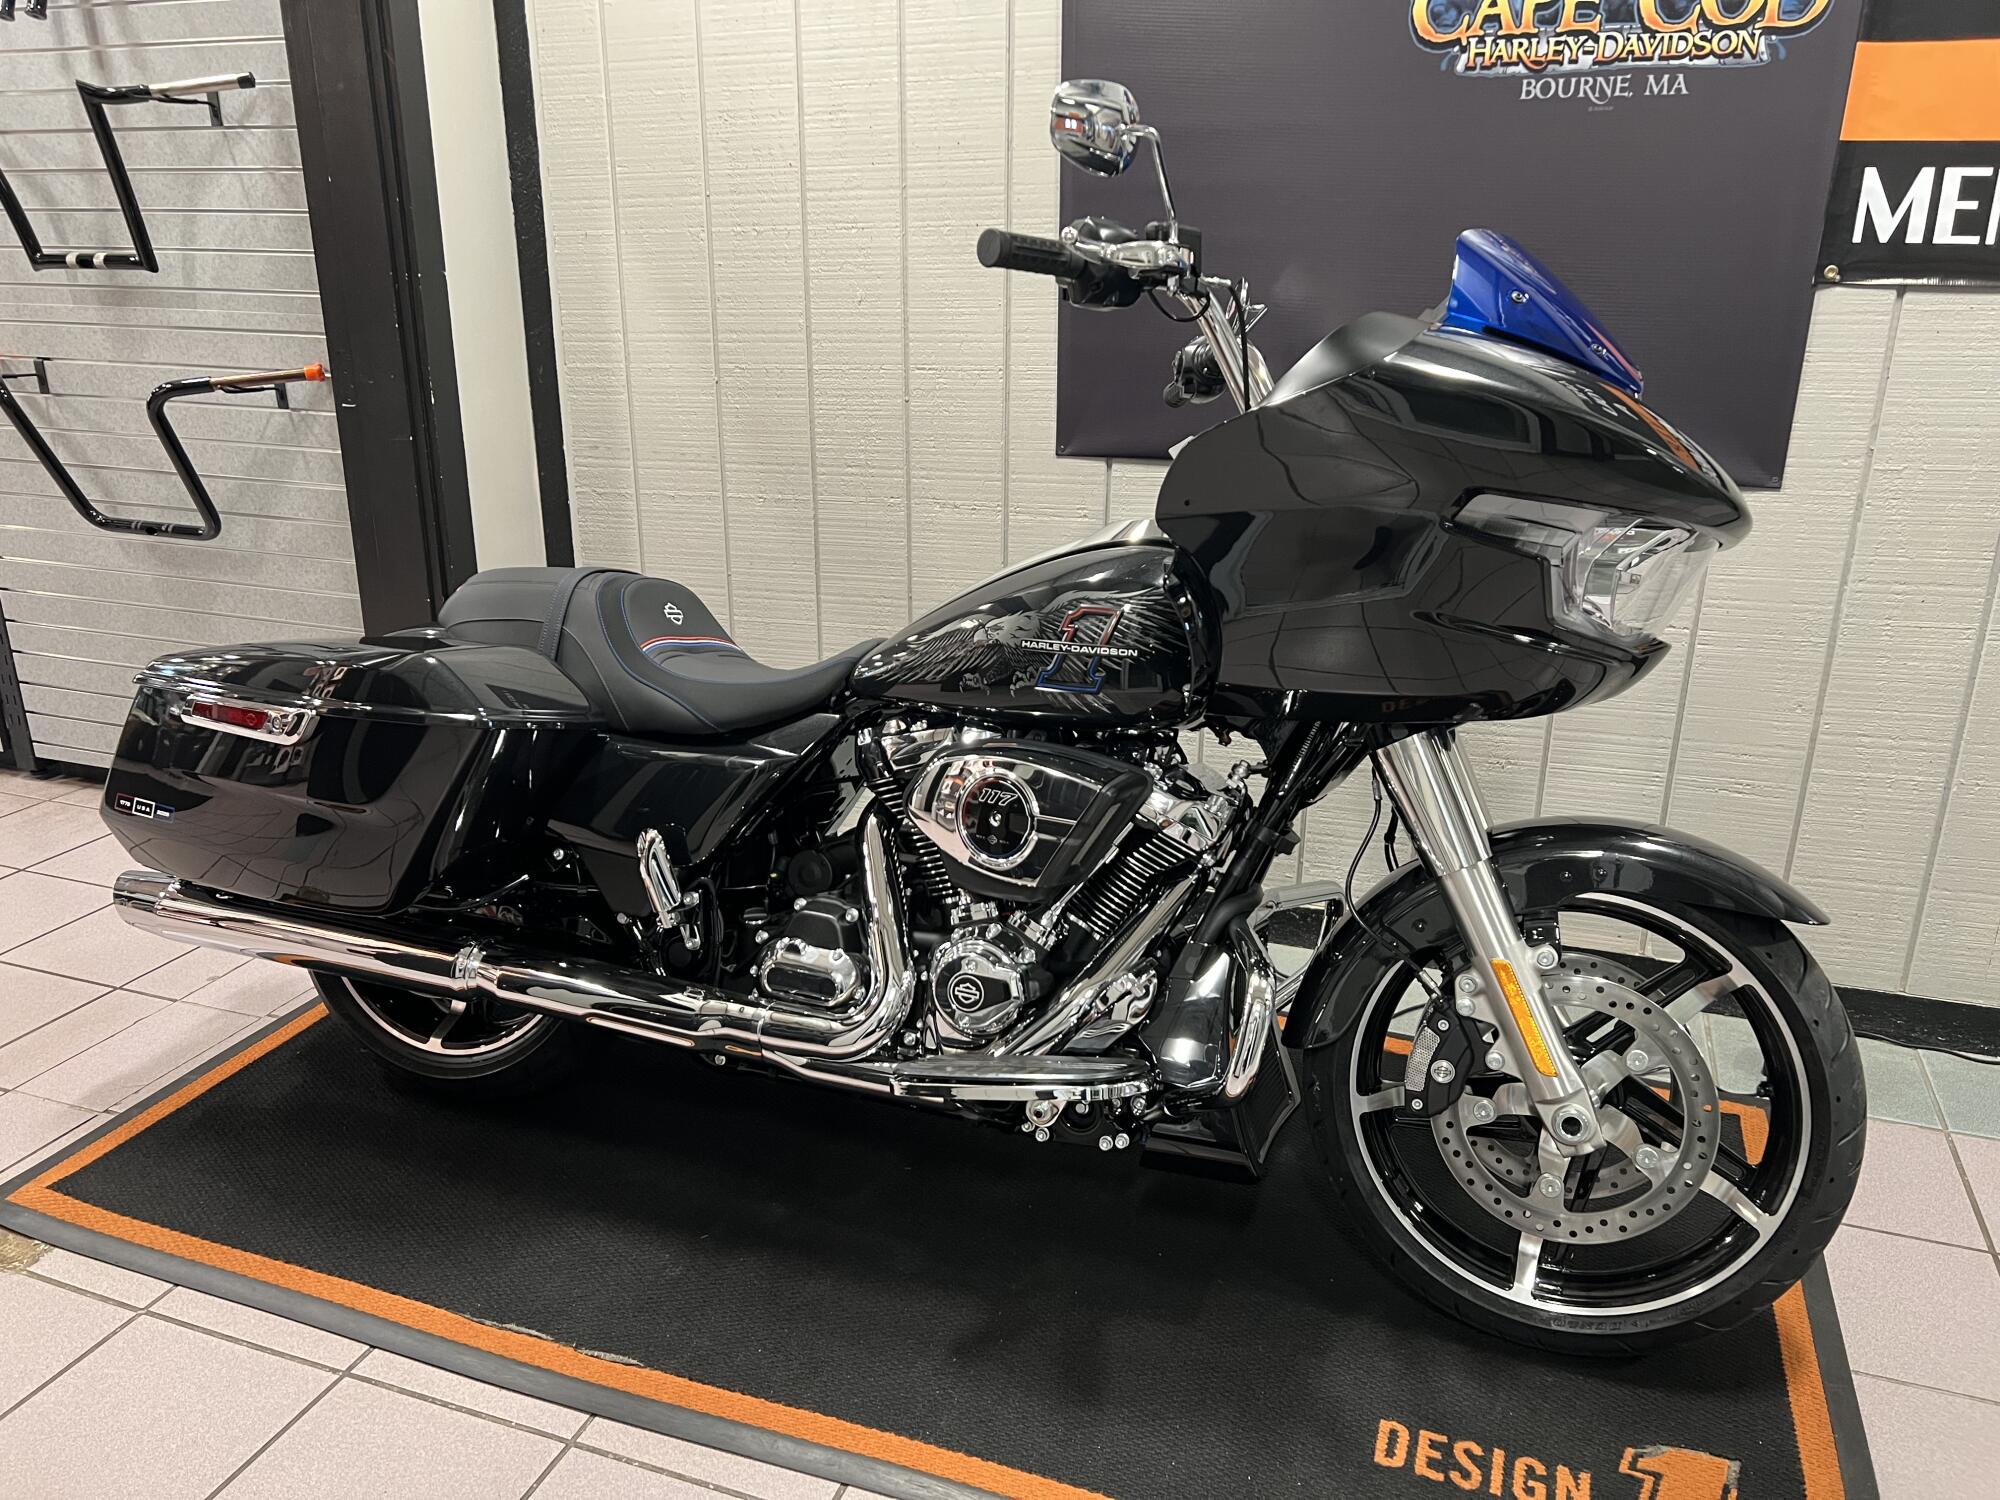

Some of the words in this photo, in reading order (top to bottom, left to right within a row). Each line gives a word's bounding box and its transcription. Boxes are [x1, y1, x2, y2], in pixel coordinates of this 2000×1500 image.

[1466, 29, 1764, 70] HARLEY-DAVIDSON
[1519, 73, 1634, 105] BOURNE,
[1643, 73, 1690, 96] MA
[1851, 166, 2000, 246] ME
[1021, 640, 1138, 657] HARLEY-DAVIDSON
[978, 788, 1018, 807] 117
[1373, 1418, 1592, 1500] DESIGN
